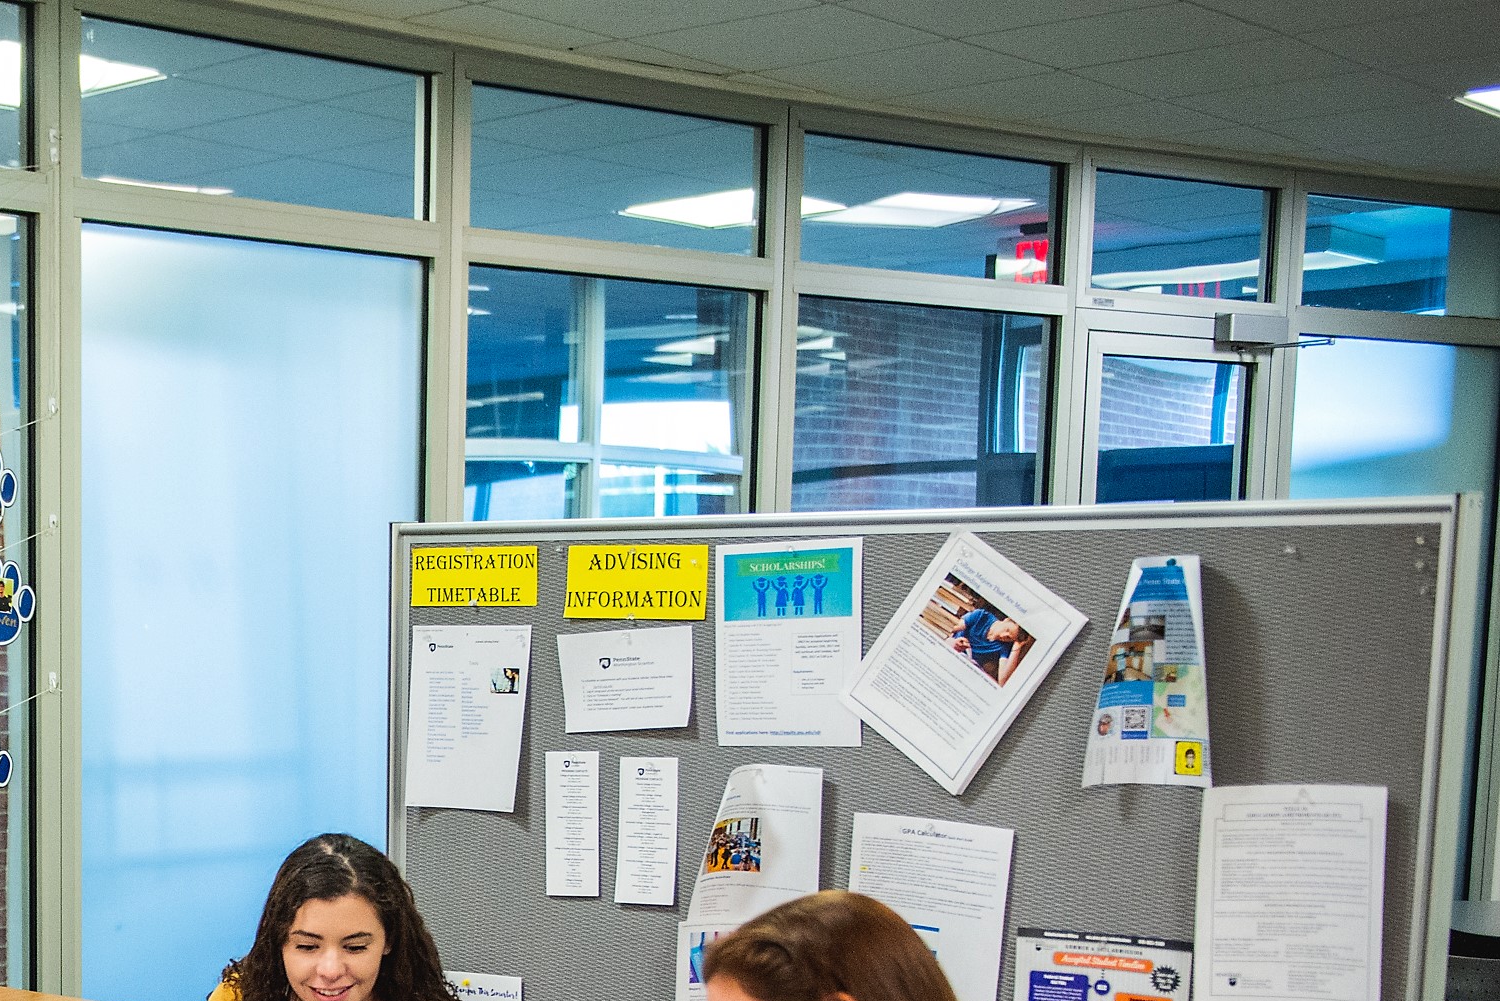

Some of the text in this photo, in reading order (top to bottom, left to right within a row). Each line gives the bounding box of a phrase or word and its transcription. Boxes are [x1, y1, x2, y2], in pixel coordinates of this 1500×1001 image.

[1014, 239, 1049, 283] EX
[415, 553, 535, 571] REGISTRATION
[588, 551, 681, 570] ADVISING
[749, 558, 826, 573] SCHOLARSHIPS!
[427, 587, 520, 603] TIMETABLE
[567, 590, 701, 608] INFORMATION
[917, 829, 948, 838] Calculator
